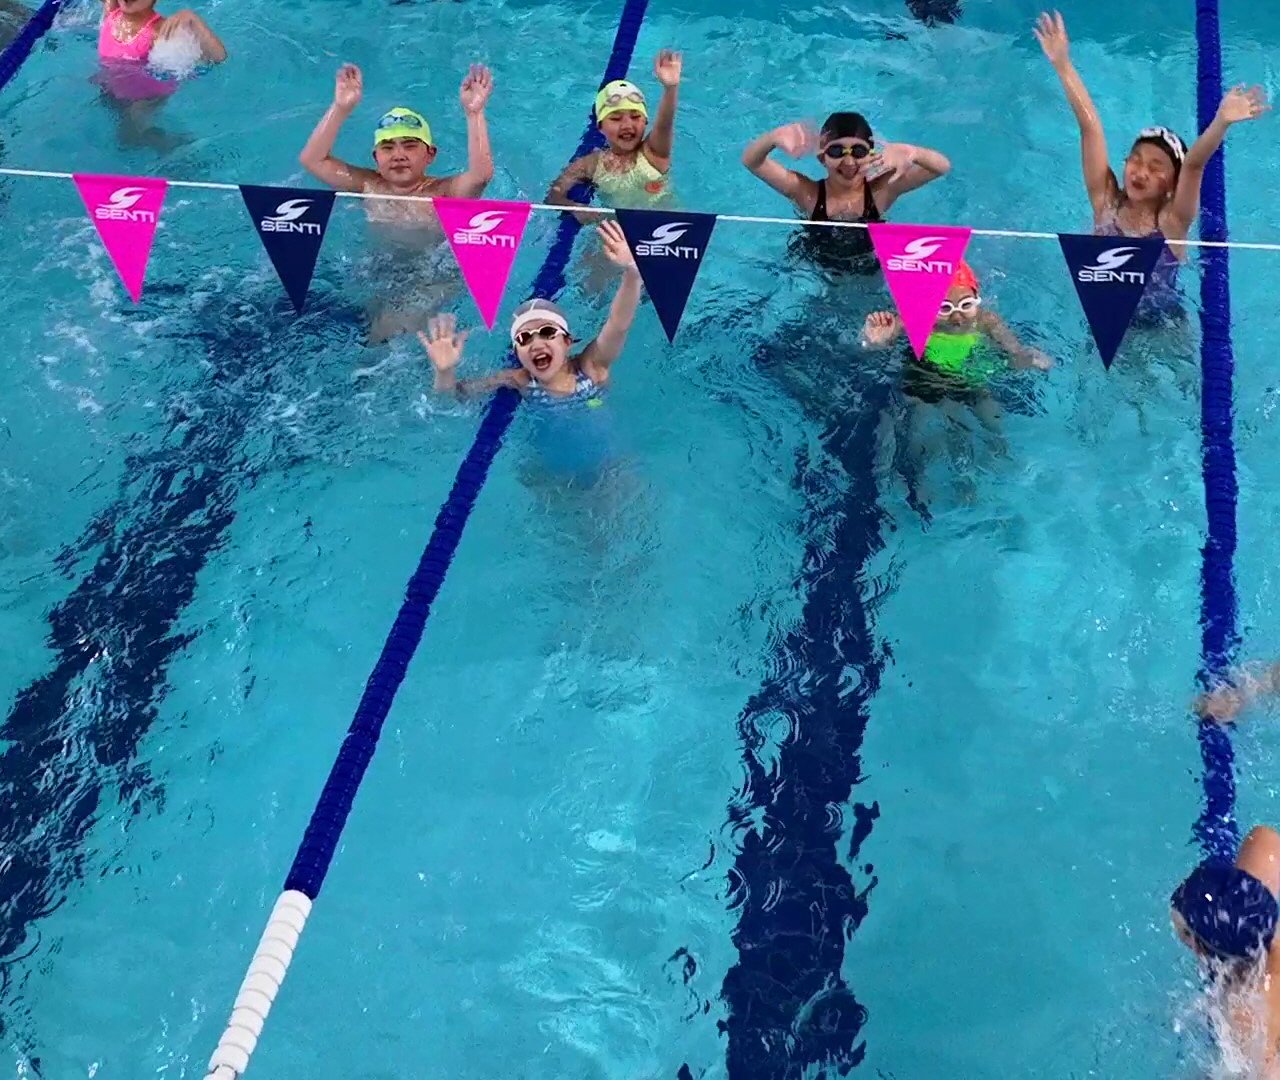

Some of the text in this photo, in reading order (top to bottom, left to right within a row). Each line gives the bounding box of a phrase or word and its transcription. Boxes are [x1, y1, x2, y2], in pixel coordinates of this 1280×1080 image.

[95, 207, 155, 223] SENTI
[260, 219, 321, 236] SENTI
[453, 231, 516, 249] SENTI
[635, 242, 699, 259] SENTI
[886, 258, 953, 275] SENTI
[1077, 268, 1146, 286] SENTI
